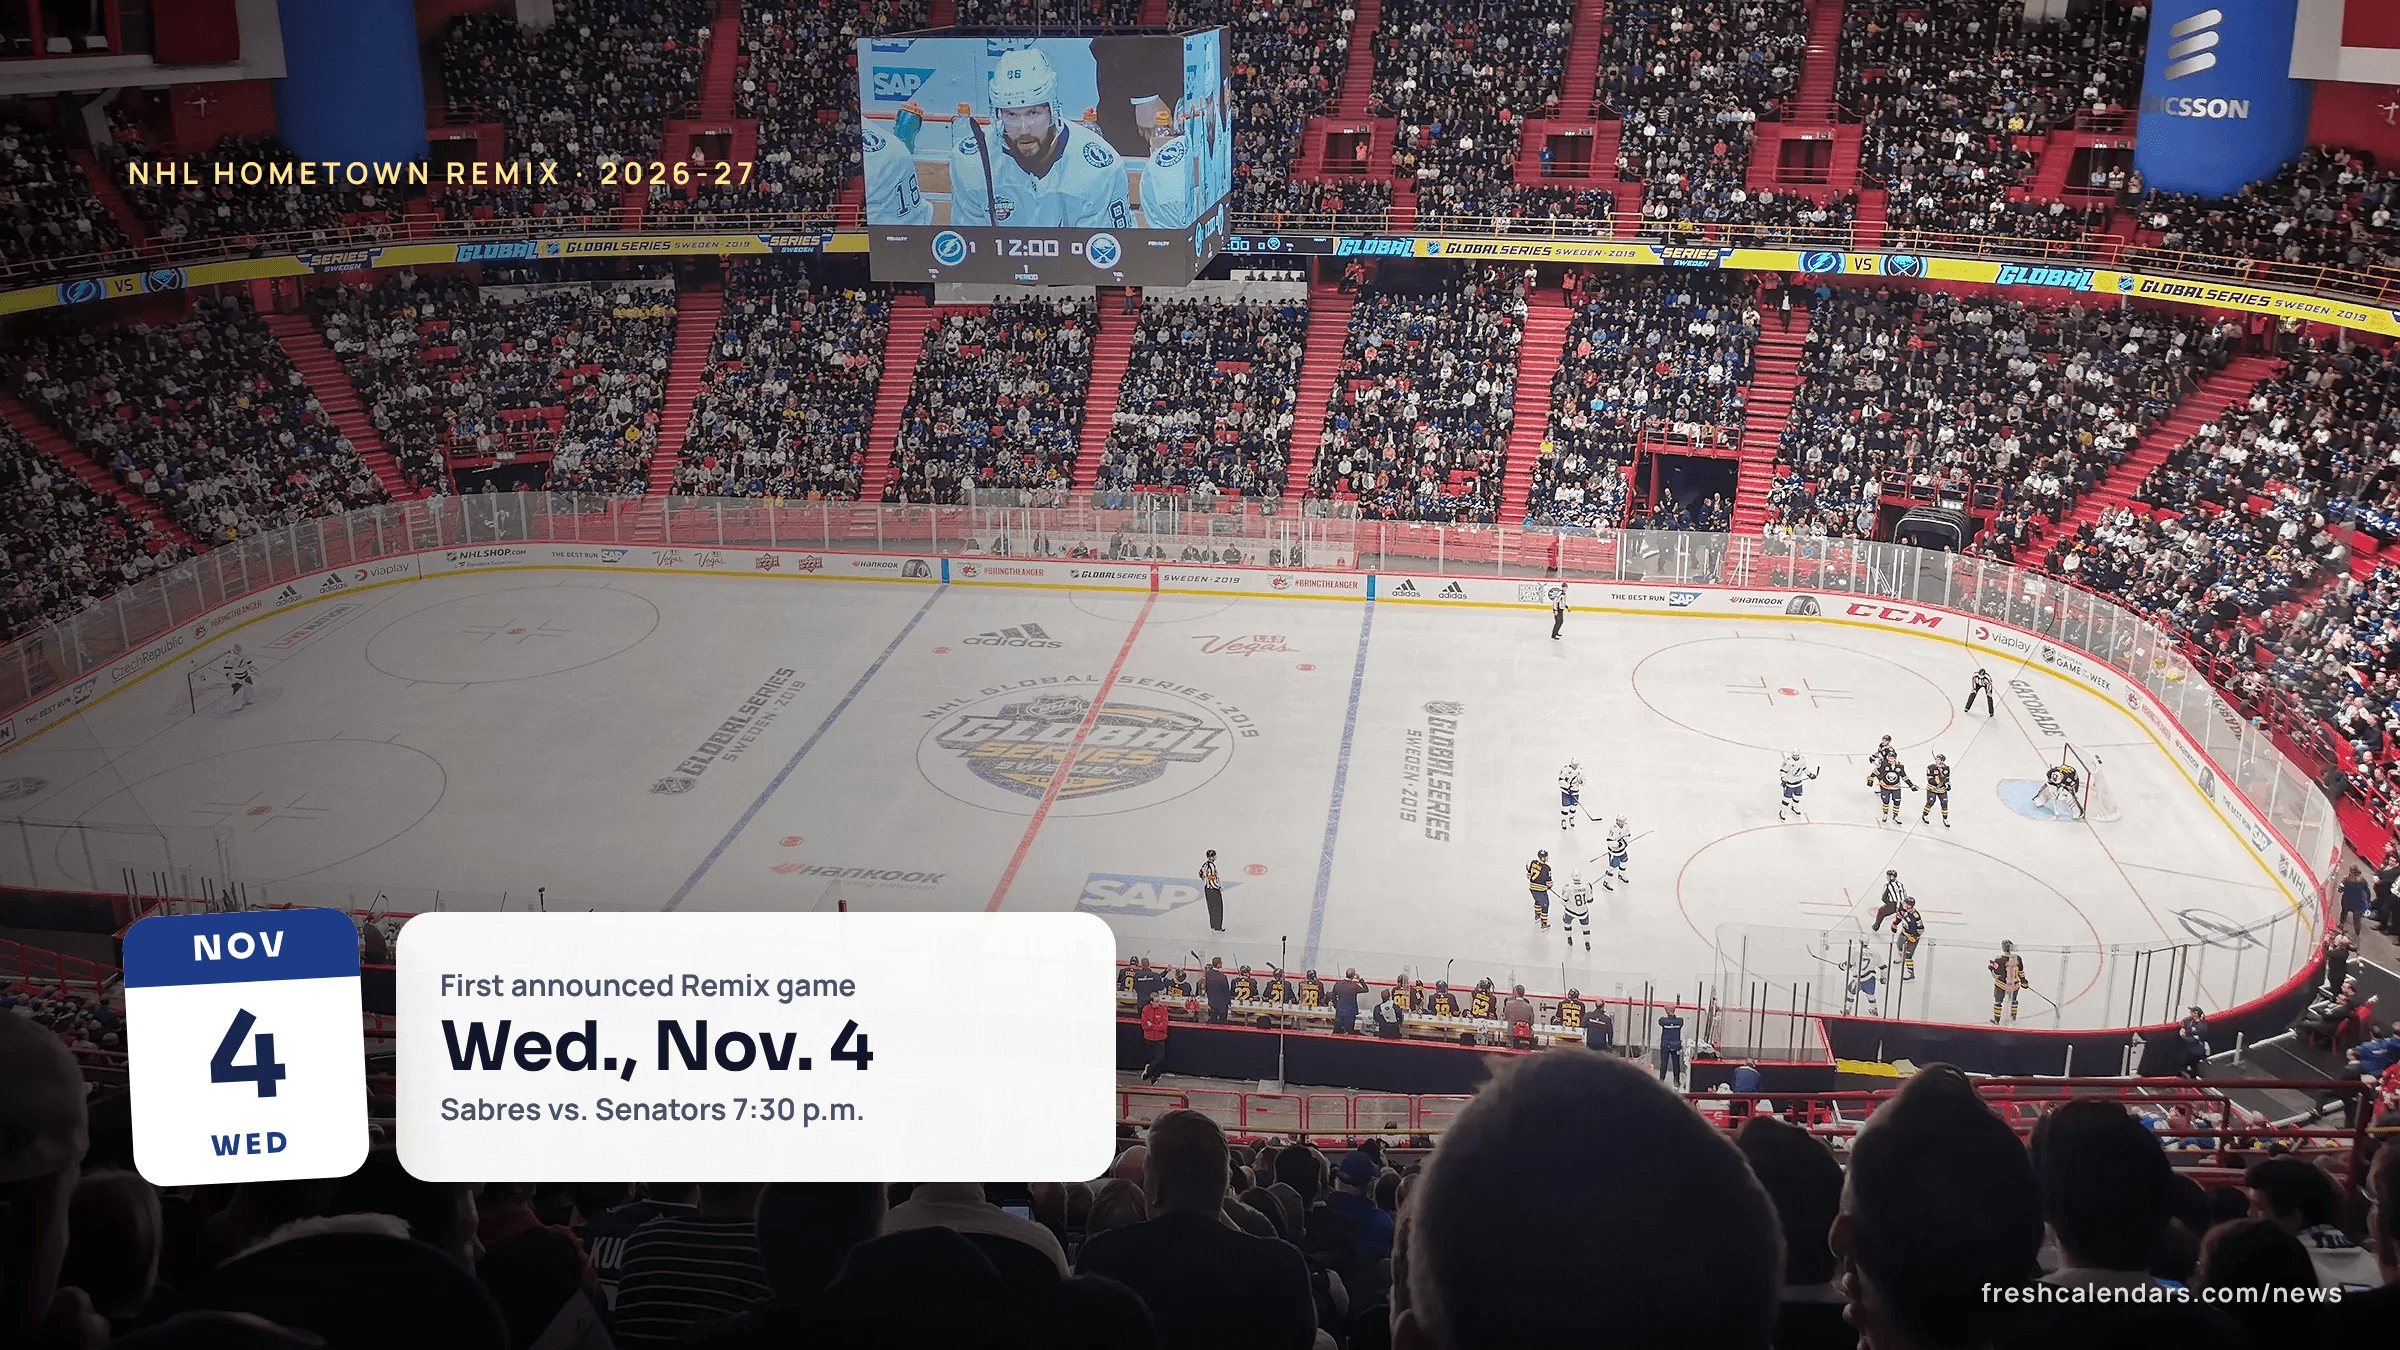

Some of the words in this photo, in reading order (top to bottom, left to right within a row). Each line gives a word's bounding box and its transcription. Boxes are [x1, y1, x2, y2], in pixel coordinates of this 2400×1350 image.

[873, 73, 921, 96] SAP
[674, 241, 719, 249] SWEDEN
[724, 241, 751, 249] 2019
[769, 234, 820, 246] SERIES
[969, 242, 976, 253] 1
[995, 238, 1059, 257] 12:00
[1071, 242, 1083, 254] 0
[1338, 237, 1415, 258] GLOBAL
[311, 251, 369, 267] SERIES
[457, 240, 539, 262] GLOBAL
[1554, 248, 1603, 257] SWEDEN
[1608, 250, 1635, 258] 2019
[1661, 247, 1719, 260] SERIES
[324, 263, 361, 273] SWEDEN
[1023, 264, 1029, 273] 1
[1672, 259, 1710, 268] SWEDEN
[1854, 258, 1873, 271] VS
[1996, 263, 2095, 291] GLOBAL
[113, 277, 134, 294] VS
[2274, 299, 2330, 315] SWEDEN
[2336, 308, 2367, 322] 2019
[602, 550, 621, 562] SAP
[370, 562, 409, 578] viaplay
[984, 566, 1044, 577] #BRINGTHEANGER
[1163, 574, 1206, 583] SWEDEN
[1214, 576, 1241, 584] 2019
[1294, 579, 1358, 590] #BRINGTHEANGER
[319, 581, 348, 594] adidas
[1391, 589, 1421, 598] adidas
[1438, 590, 1468, 600] adidas
[275, 592, 303, 608] adidas
[1611, 593, 1626, 601] THE
[1669, 592, 1693, 606] SAP
[1846, 602, 1943, 629] CCM
[962, 635, 1063, 649] adidas
[1191, 635, 1300, 657] Vegas
[1253, 635, 1286, 644] LAS
[1991, 632, 2031, 653] viaplay
[2056, 658, 2081, 676] GAME
[2089, 672, 2111, 691] WEEK
[24, 713, 39, 725] THE
[39, 703, 56, 718] BEST
[57, 696, 71, 709] RUN
[73, 681, 95, 701] SAP
[922, 697, 973, 720] NHL
[979, 673, 1100, 697] GLOBAL
[1118, 674, 1214, 702] SERIES
[1221, 705, 1260, 739] 2019
[2008, 679, 2067, 739] GATORADE
[722, 711, 777, 763] SWEDEN
[774, 680, 806, 707] 2019
[938, 716, 1224, 757] GLOBAL
[971, 741, 1160, 765] SERIES
[1403, 728, 1423, 783] SWEDEN
[1400, 786, 1418, 823] 2019
[1079, 880, 1200, 914] SAP
[1574, 893, 1587, 907] 81
[1234, 987, 1251, 1001] 22
[1302, 989, 1319, 1007] 28
[1472, 999, 1489, 1016] 62
[1562, 1008, 1582, 1027] 55
